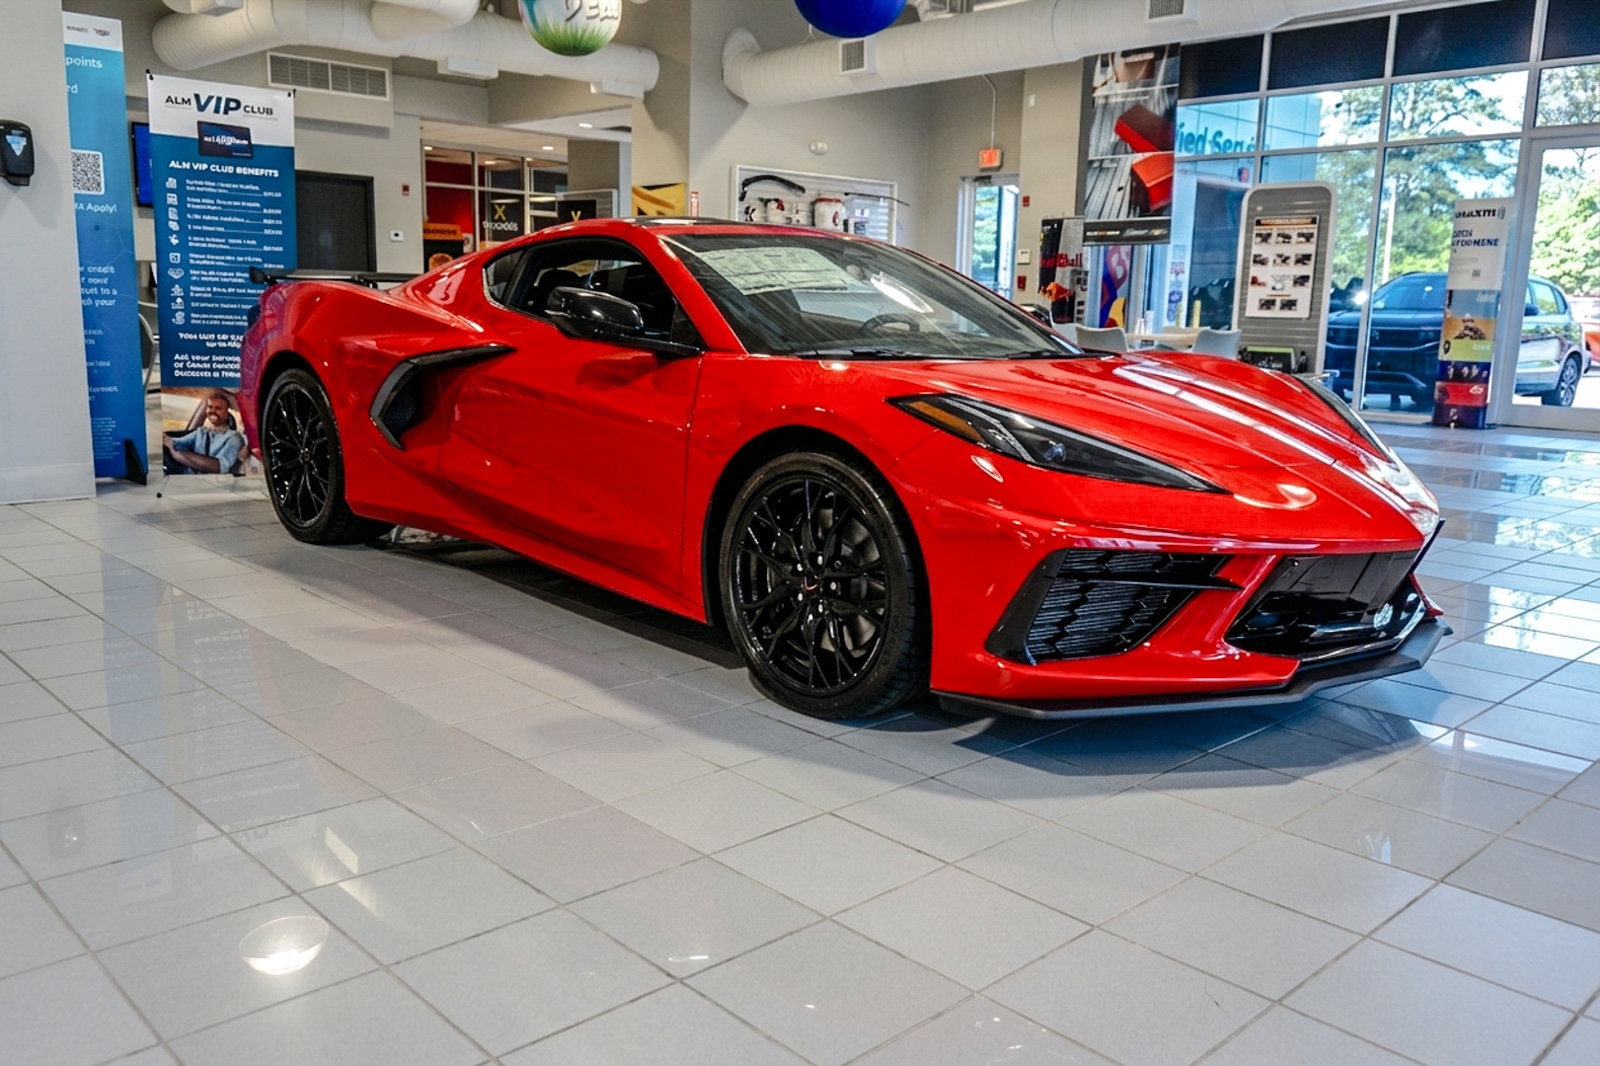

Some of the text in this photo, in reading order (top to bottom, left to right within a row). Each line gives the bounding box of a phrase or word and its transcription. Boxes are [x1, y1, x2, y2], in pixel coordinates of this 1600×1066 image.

[65, 56, 103, 69] points
[165, 93, 274, 116] ALM VIP CLUB
[169, 160, 279, 178] ALM VIP CLUB BENEFITS
